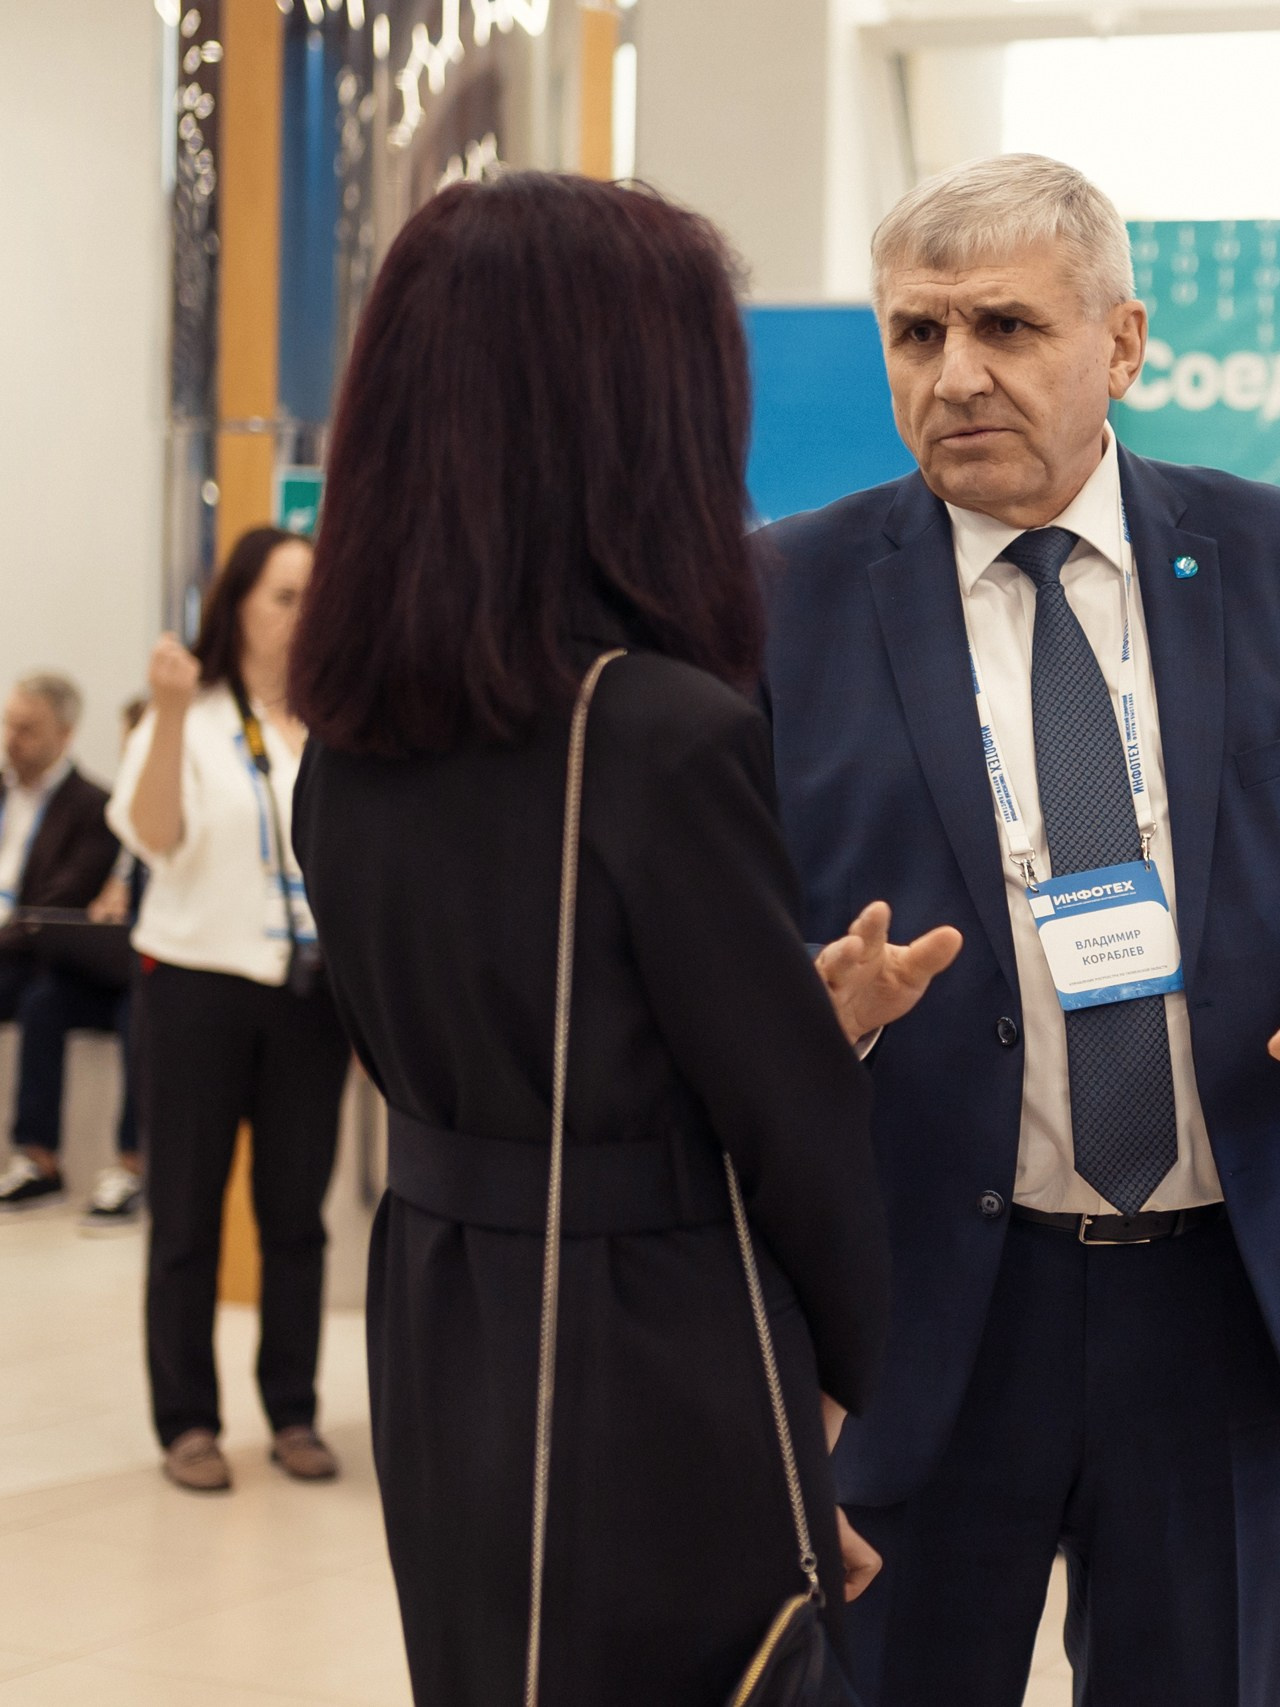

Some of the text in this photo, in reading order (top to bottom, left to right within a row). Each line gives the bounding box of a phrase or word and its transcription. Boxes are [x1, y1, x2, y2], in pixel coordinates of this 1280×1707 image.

[980, 724, 1002, 774] ИНФОТЕХ
[1128, 743, 1144, 795] ИНФОТЕХ
[1053, 881, 1135, 905] ИНФОТЕХ
[1075, 929, 1141, 950] ВЛАДИМИР
[1082, 946, 1144, 966] КОРАБЛЕВ
